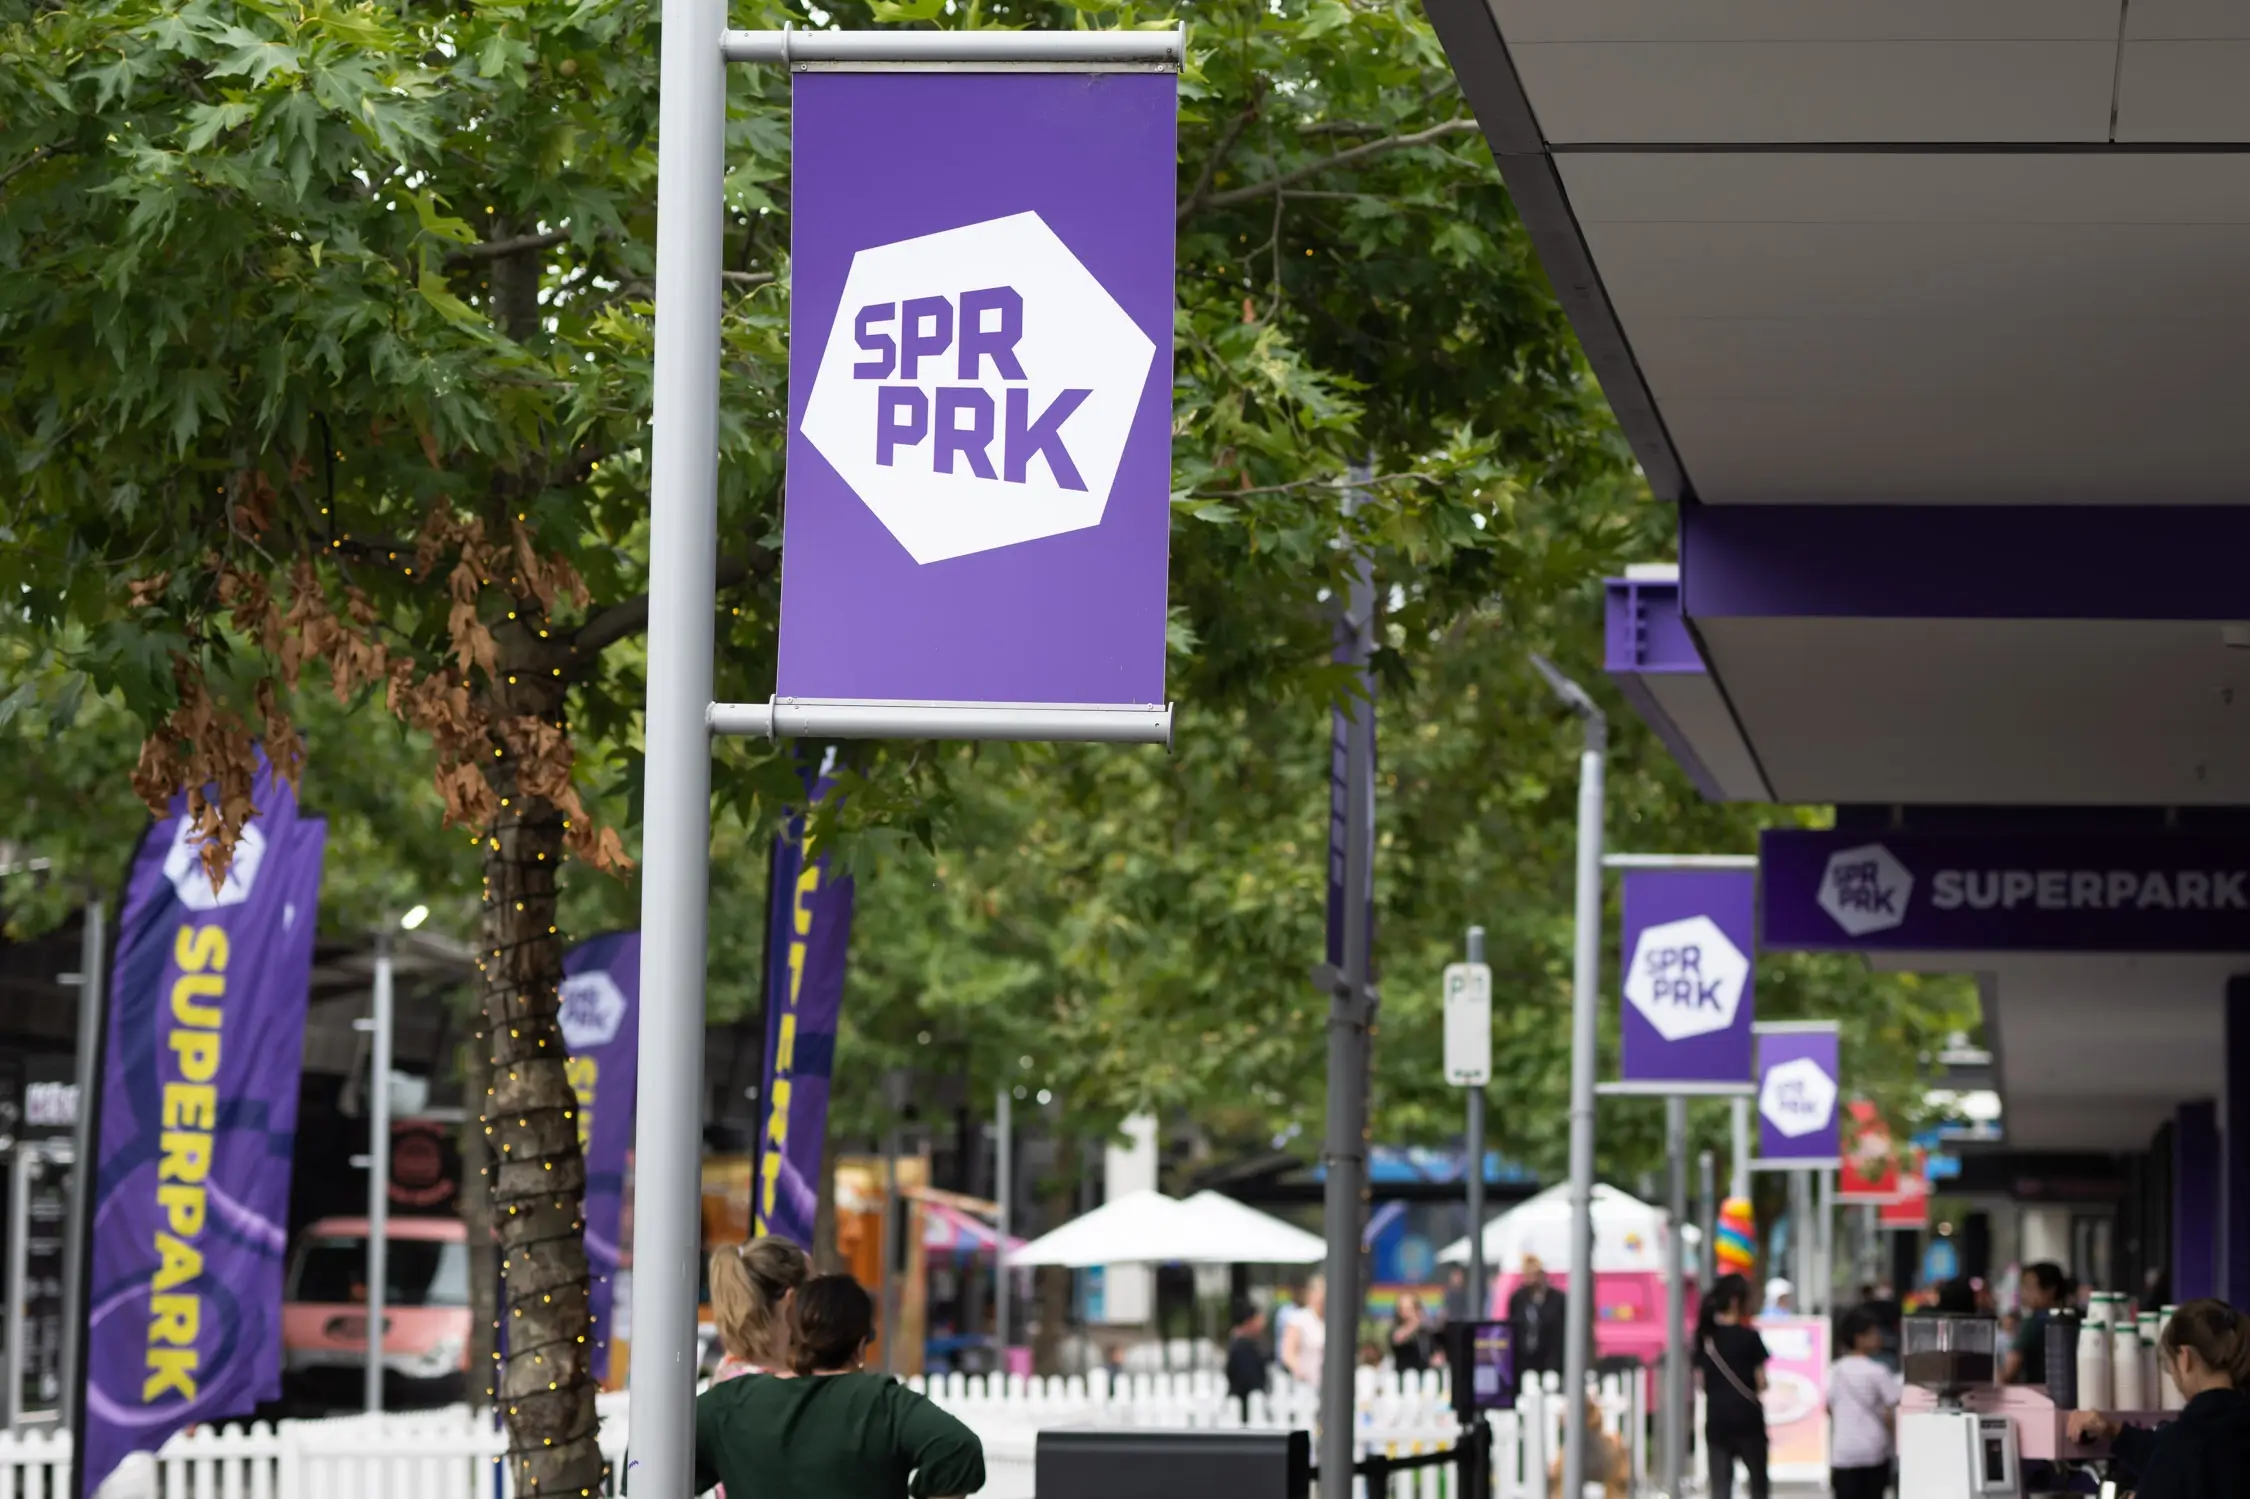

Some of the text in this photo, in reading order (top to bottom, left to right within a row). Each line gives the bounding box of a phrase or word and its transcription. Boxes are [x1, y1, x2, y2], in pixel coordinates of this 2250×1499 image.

[853, 286, 1028, 380] SPR
[876, 386, 1094, 492] PRK
[1832, 860, 1879, 889] SPR
[1932, 869, 2249, 910] SUPERPARK
[1838, 886, 1896, 915] PRK
[1646, 945, 1702, 975] SPR
[1653, 979, 1723, 1013] PRK
[143, 924, 229, 1404] SUPERPARK
